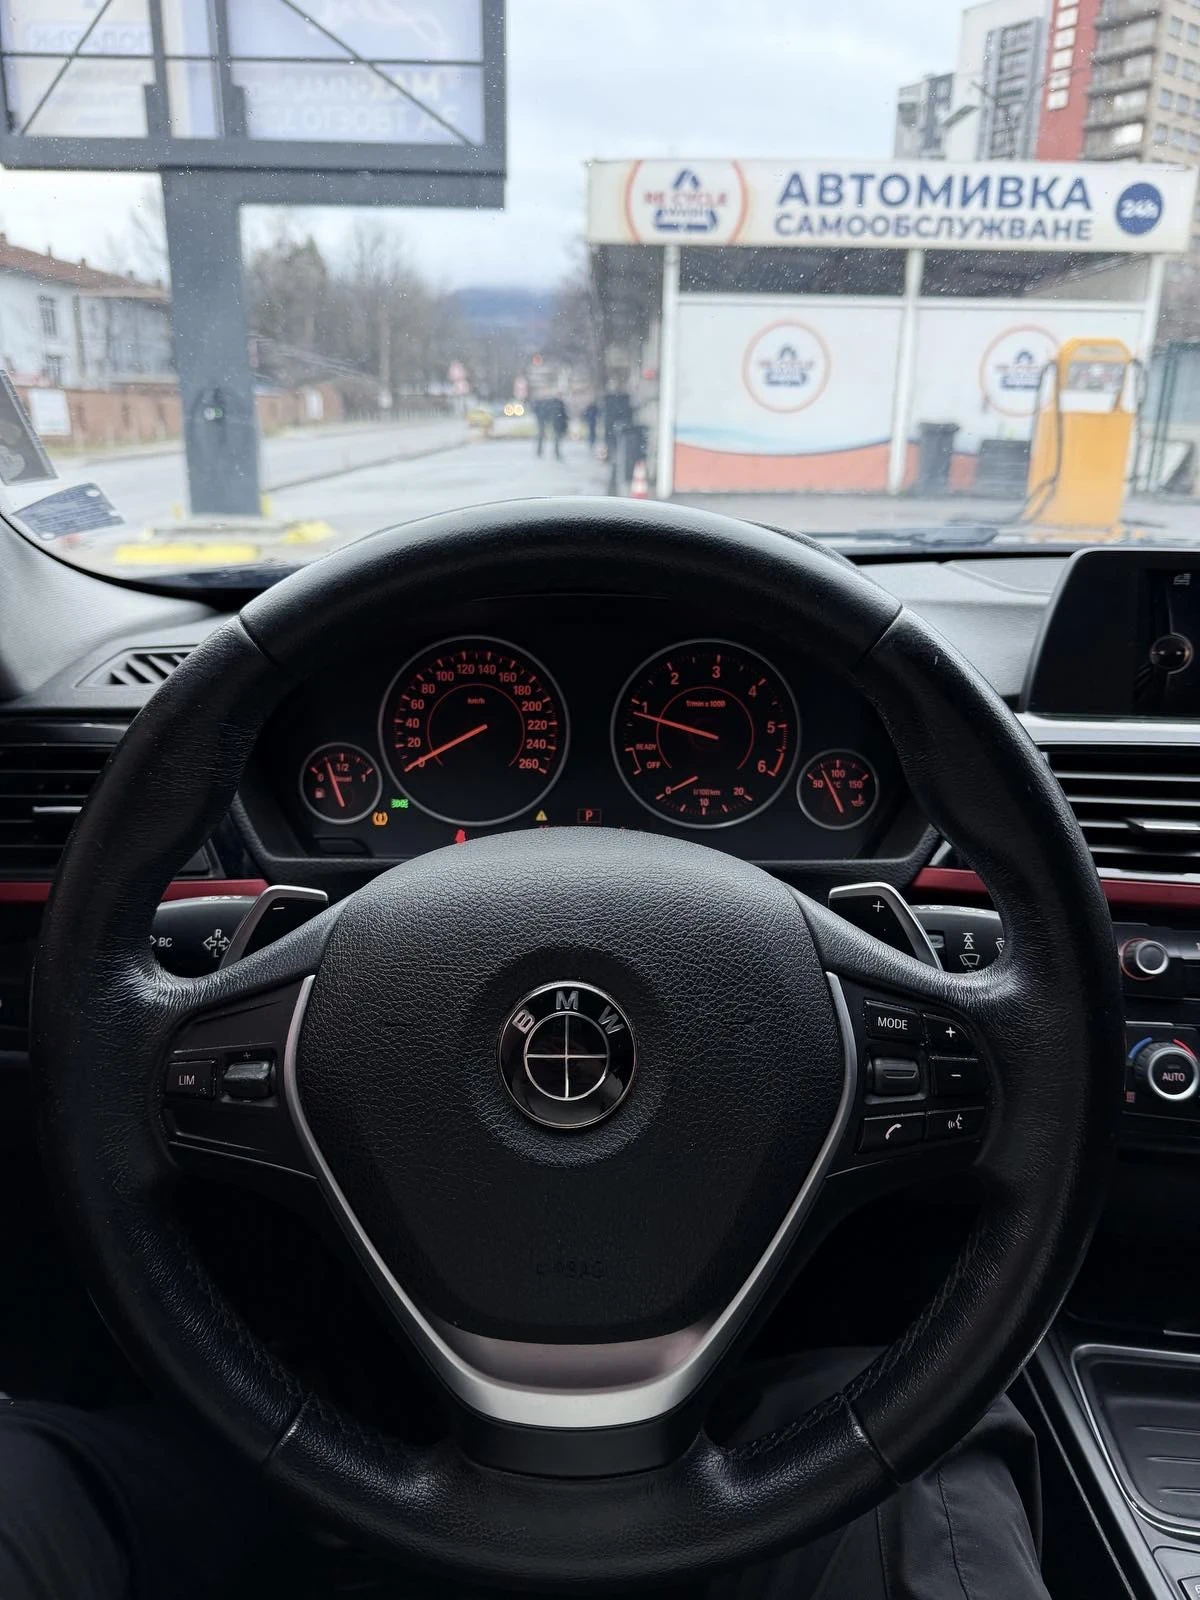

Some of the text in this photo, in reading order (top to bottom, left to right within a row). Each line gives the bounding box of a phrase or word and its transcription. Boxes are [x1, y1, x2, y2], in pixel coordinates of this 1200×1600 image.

[778, 171, 1092, 211] АВТОМИВКА
[774, 213, 1093, 242] САМООБСЛУЖВАНЕ
[457, 664, 475, 674] 120
[478, 664, 496, 674] 140
[712, 666, 721, 678] 3
[436, 671, 454, 681] 100
[499, 672, 517, 682] 160
[670, 672, 679, 685] 2
[421, 684, 435, 694] 80
[513, 685, 531, 695] 180
[748, 686, 757, 698] 4
[411, 700, 424, 710] 60
[522, 701, 542, 711] 200
[642, 702, 648, 713] 1
[405, 718, 420, 728] 40
[528, 720, 547, 730] 220
[767, 722, 776, 734] 5
[407, 737, 421, 748] 20
[526, 739, 546, 749] 240
[519, 758, 539, 769] 260
[757, 761, 766, 773] 6
[831, 769, 846, 778] 100
[733, 787, 744, 796] 20
[700, 798, 709, 806] 10
[585, 809, 593, 821] P
[214, 929, 222, 939] R
[158, 937, 172, 947] BC
[213, 949, 219, 958] L
[512, 990, 625, 1034] BMW
[877, 1016, 908, 1030] MODE
[178, 1075, 195, 1086] LIM
[1162, 1072, 1185, 1082] AUTO
